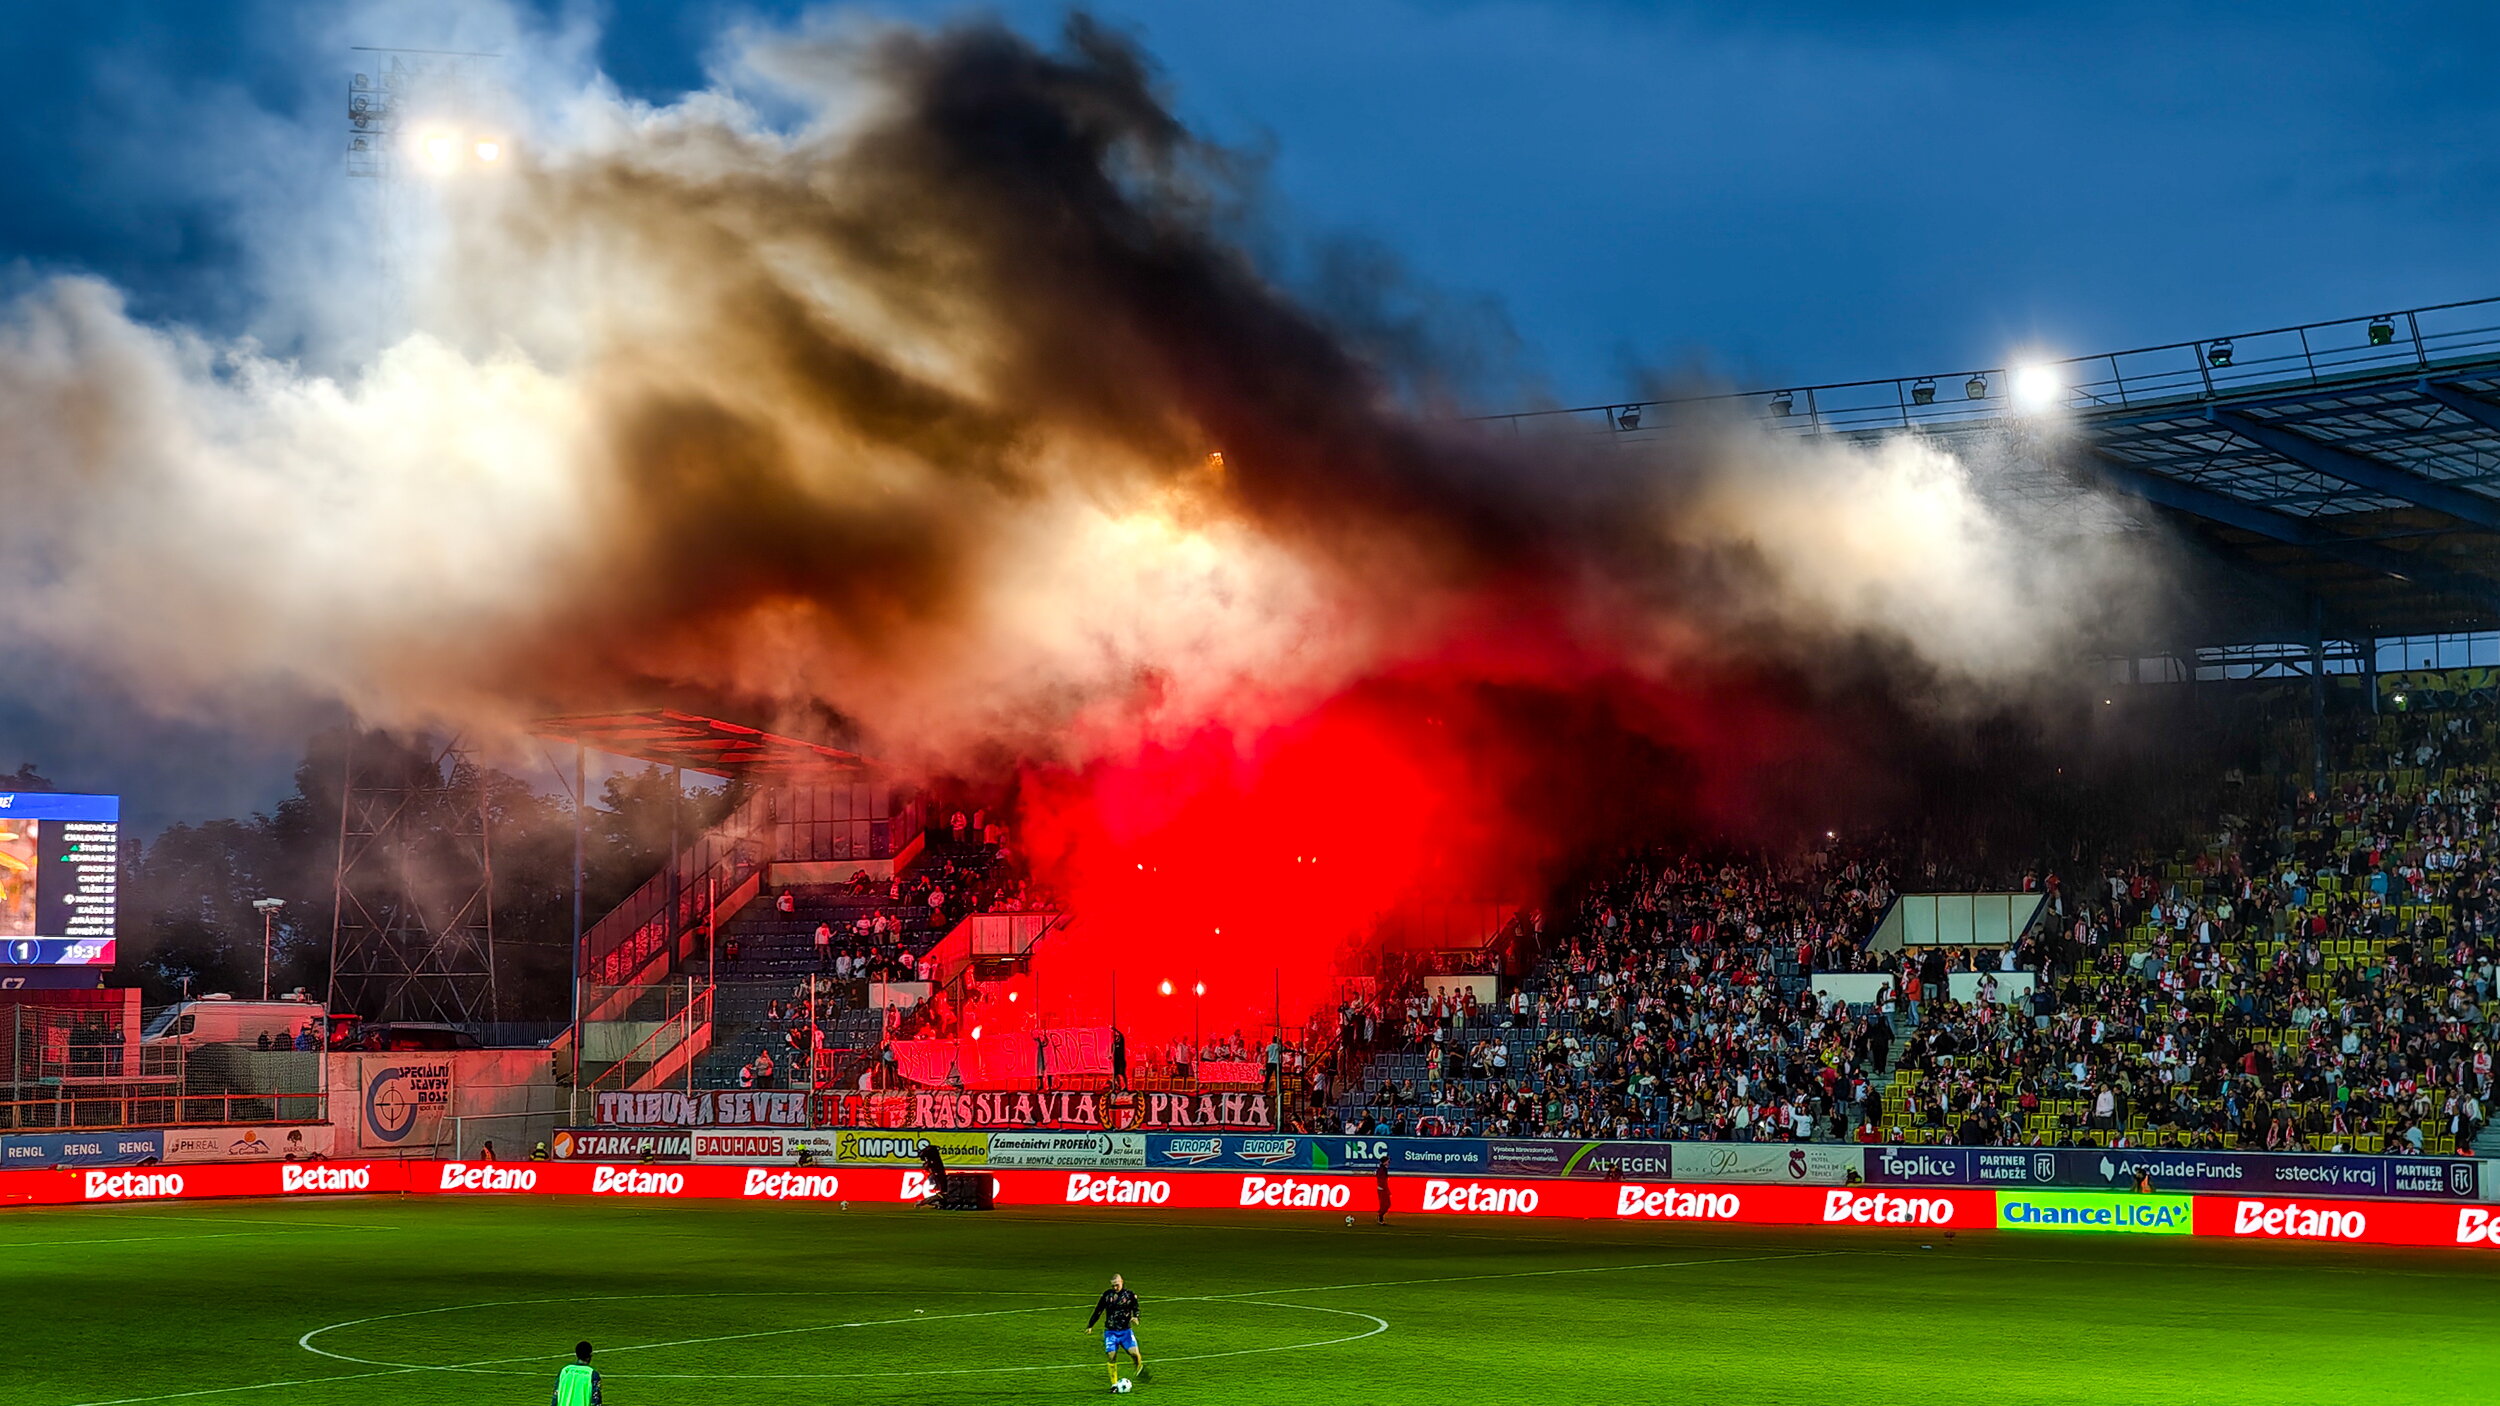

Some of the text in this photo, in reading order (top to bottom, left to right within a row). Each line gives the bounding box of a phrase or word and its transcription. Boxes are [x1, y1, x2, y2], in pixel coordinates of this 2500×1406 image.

[17, 942, 29, 960] 1
[598, 1092, 806, 1125] TRIBUNA SEVER
[976, 1092, 1098, 1125] SLAVIA
[1148, 1092, 1271, 1126] PRAHA
[8, 1141, 155, 1158] RENGL RENGL RENGL
[577, 1136, 691, 1155] STARK-KLIMA
[697, 1138, 782, 1153] BAUHAUS
[994, 1138, 1098, 1150] Zámečnictví PROFEKO
[1404, 1150, 1478, 1163] Stavíme pro vás
[989, 1156, 1014, 1164] VÝROBA
[1026, 1156, 1054, 1165] MONTÁŽ
[1057, 1156, 1096, 1166] OCELOVÝCH
[1588, 1157, 1666, 1172] ALKEGEN
[1880, 1155, 1956, 1180] Teplice
[1980, 1156, 2026, 1166] PARTNER
[1980, 1167, 2026, 1179] MLÁDEŽE
[2396, 1165, 2442, 1176] PARTNER
[86, 1172, 183, 1198] Betano
[282, 1165, 370, 1191] Betano
[440, 1164, 536, 1190] Betano
[592, 1167, 683, 1193] Betano
[744, 1169, 838, 1198] Betano
[1066, 1174, 1170, 1203] Betano
[2343, 1166, 2376, 1186] kraj
[2396, 1177, 2444, 1192] MLÁDEŽE
[1240, 1177, 1350, 1207] Betano
[1423, 1180, 1538, 1212] Betano
[1617, 1186, 1740, 1218] Betano
[1824, 1190, 1954, 1223] Betano
[2004, 1202, 2174, 1227] Chance LIGA
[2235, 1201, 2365, 1238] Betano
